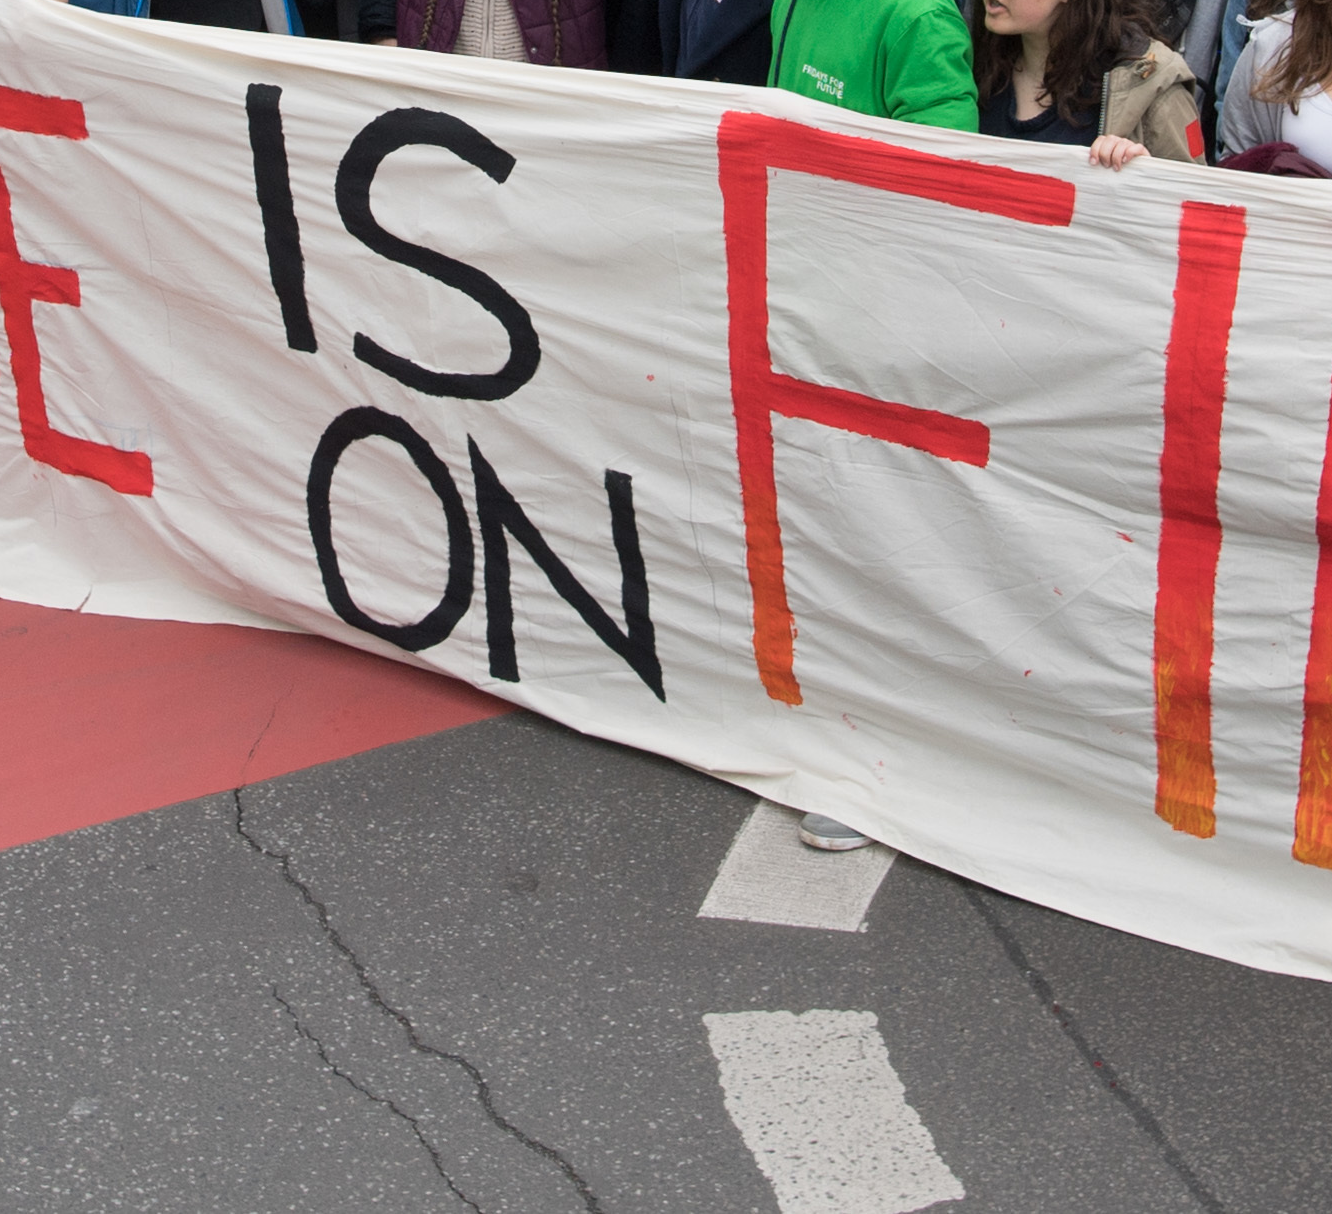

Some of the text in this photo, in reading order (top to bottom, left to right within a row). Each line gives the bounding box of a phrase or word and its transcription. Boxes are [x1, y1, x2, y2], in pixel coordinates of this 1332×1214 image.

[802, 64, 845, 91] FRIDAYS FOR
[245, 80, 547, 404] IS
[304, 402, 668, 704] ON
